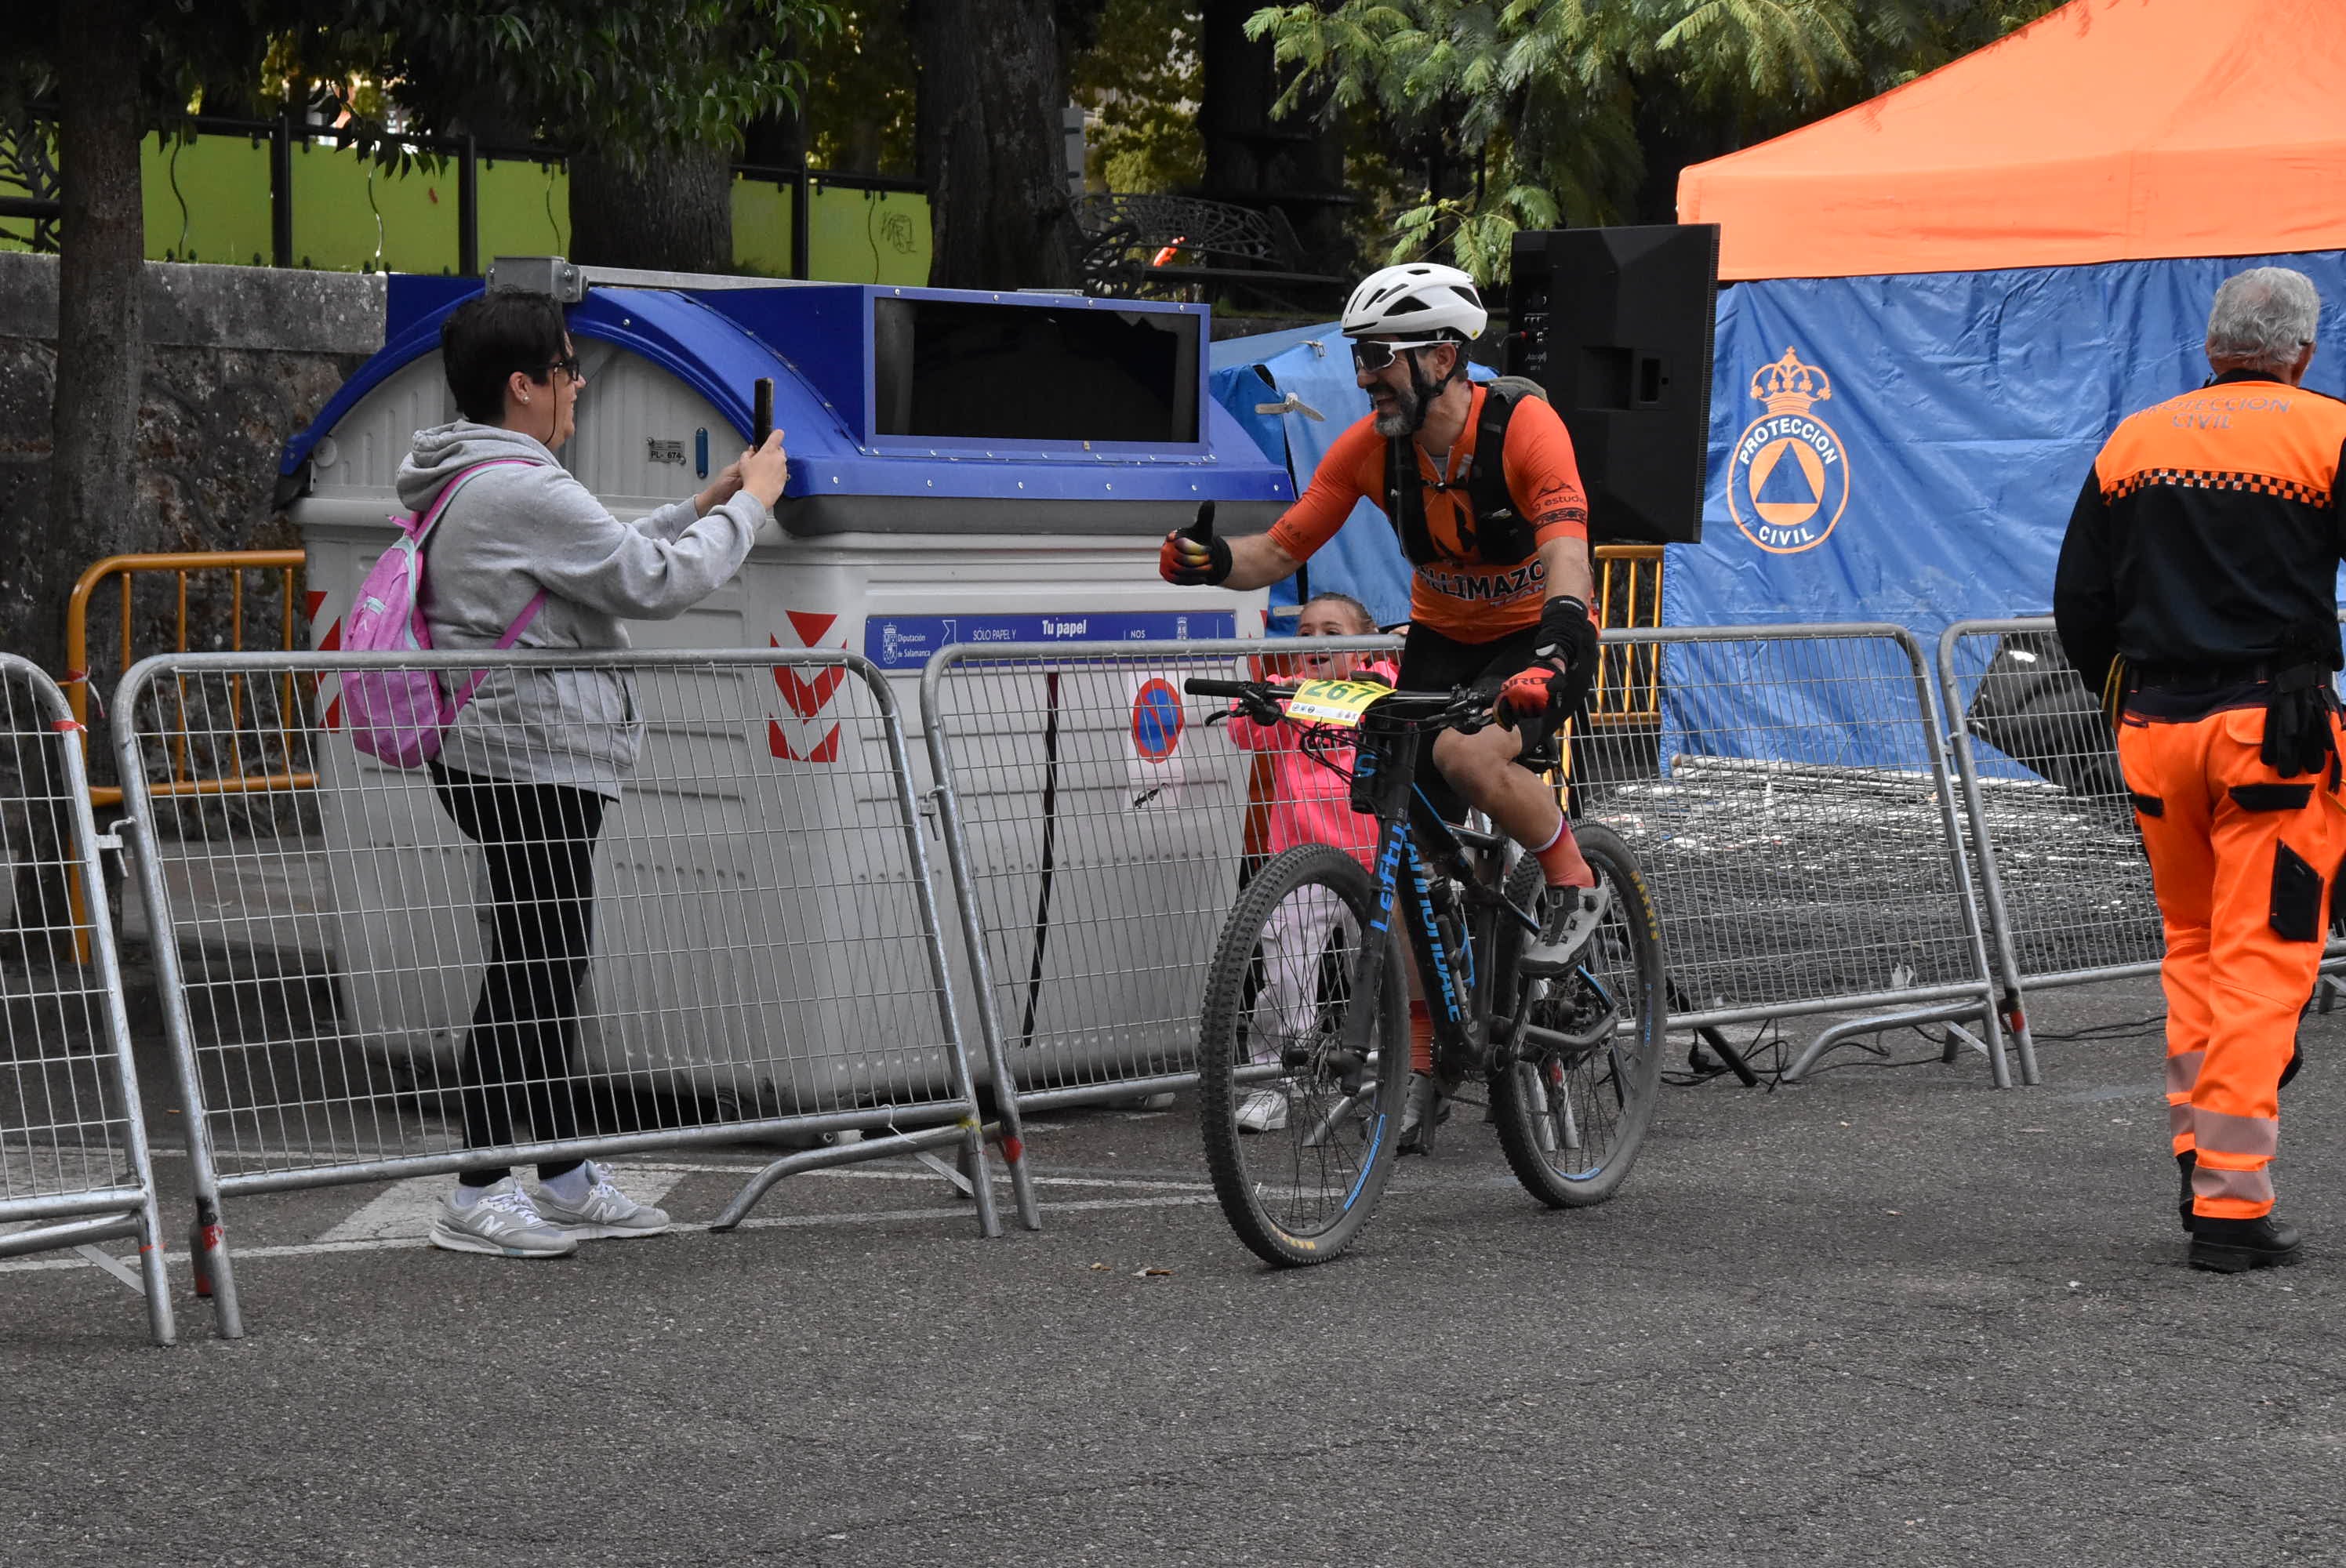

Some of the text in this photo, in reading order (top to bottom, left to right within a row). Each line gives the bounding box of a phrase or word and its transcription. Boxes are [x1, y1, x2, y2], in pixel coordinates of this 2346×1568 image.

[2172, 413, 2232, 430] CIVIL
[1738, 418, 1838, 465] PROTECCION
[1759, 525, 1815, 546] CIVIL
[973, 627, 1017, 641] SÓLO PAPEL Y
[1042, 619, 1087, 637] Tu papel
[898, 633, 925, 643] Diputación
[903, 648, 931, 658] Salamanca
[1304, 679, 1377, 704] 267
